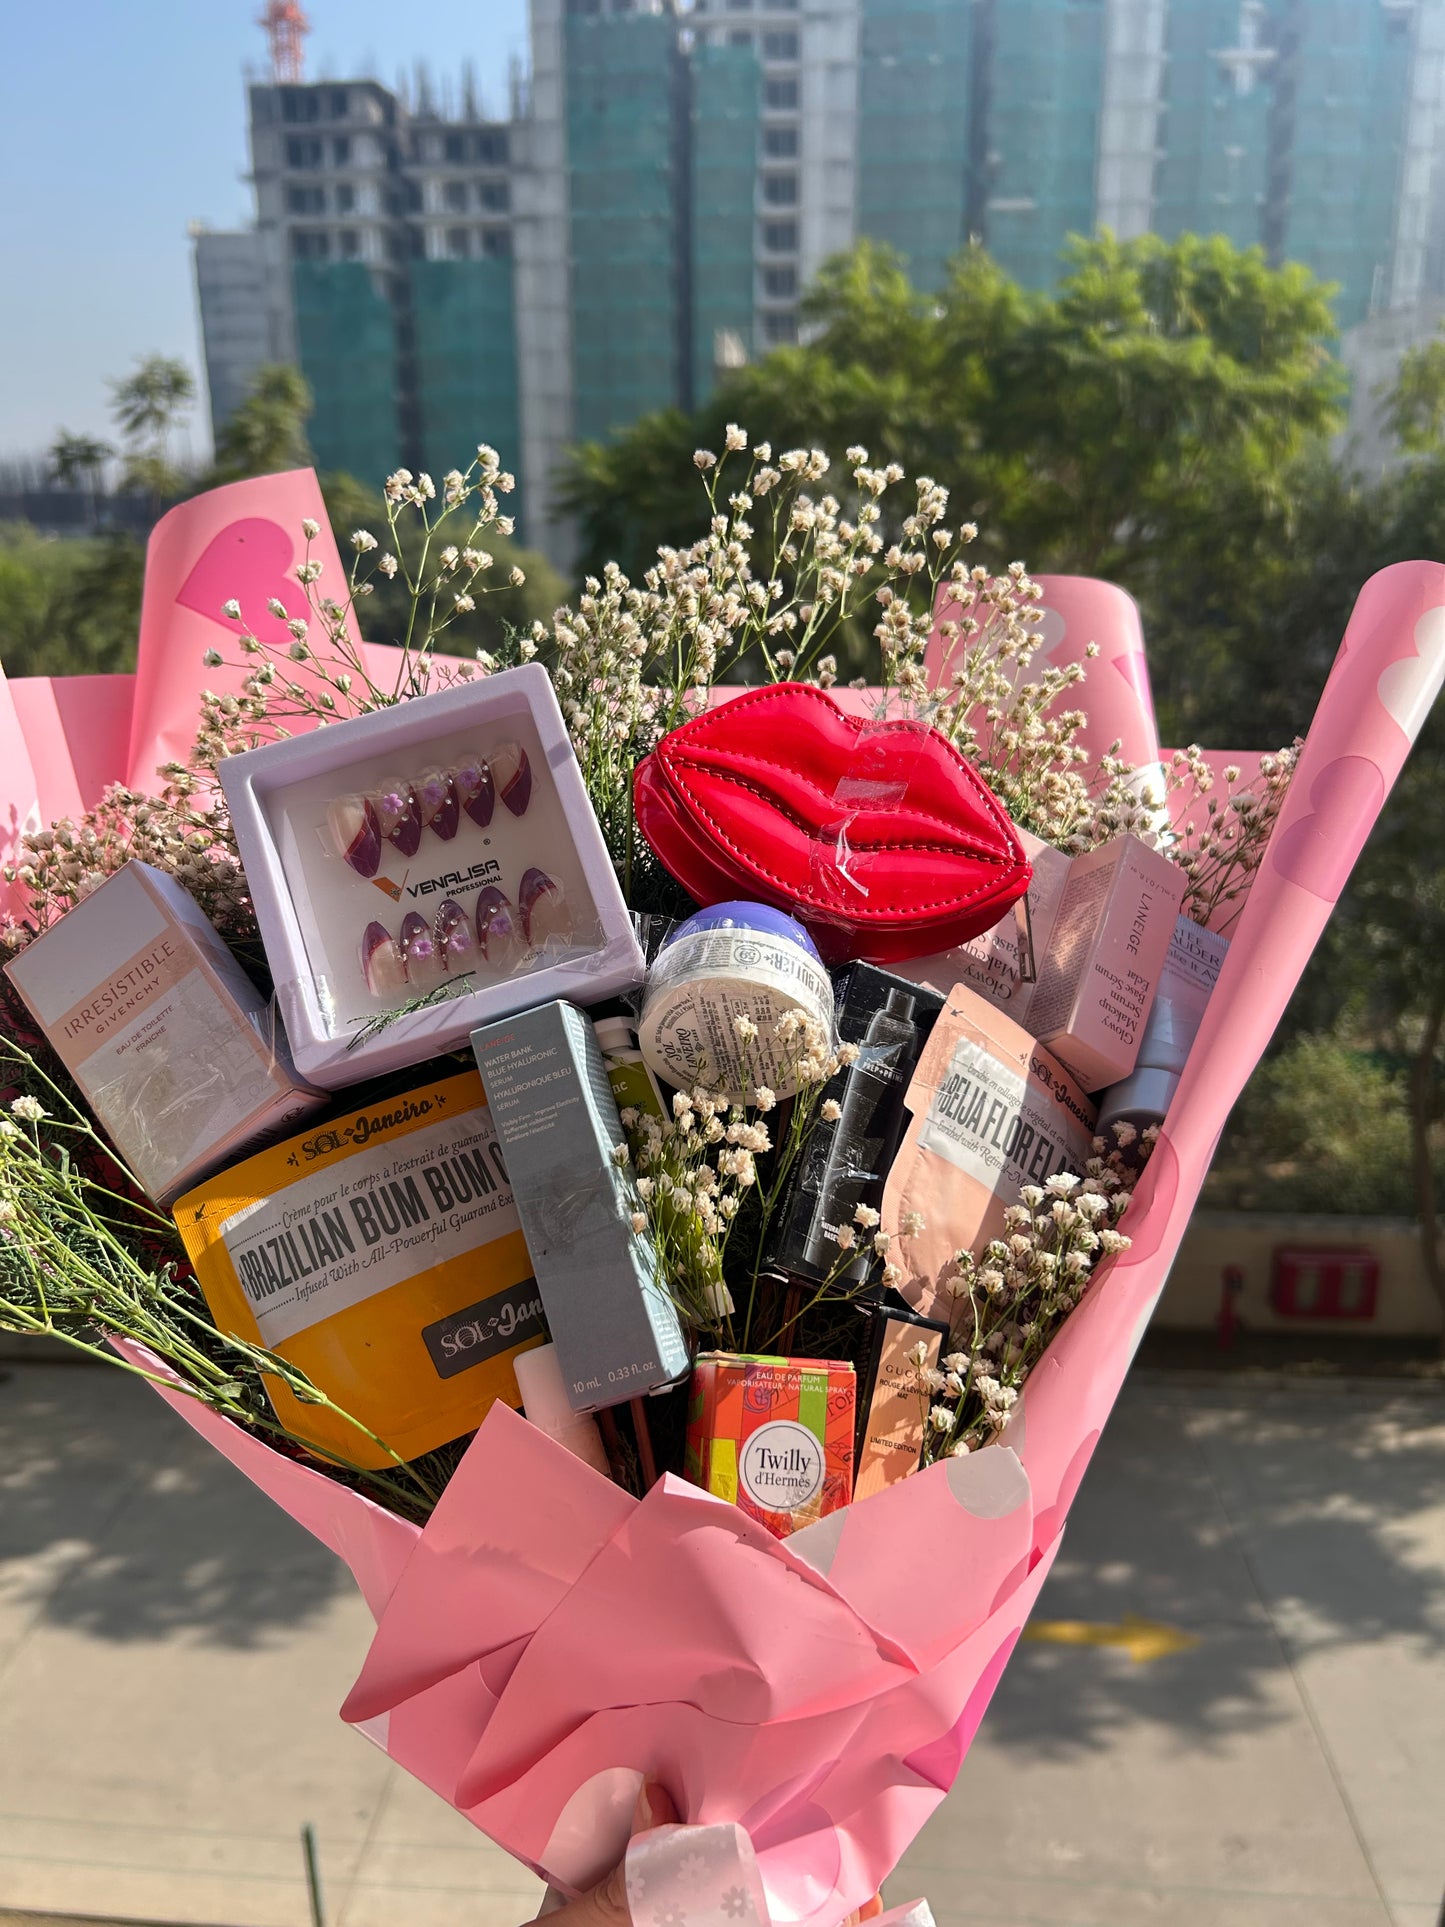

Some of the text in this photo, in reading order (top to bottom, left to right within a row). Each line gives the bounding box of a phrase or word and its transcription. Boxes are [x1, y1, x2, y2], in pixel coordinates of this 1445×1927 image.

[406, 859, 500, 898] VENALISA
[446, 875, 503, 897] PROFESSIONAL
[1126, 892, 1153, 956] LANEIGE
[963, 963, 1012, 1000] Glowy
[1125, 984, 1145, 1005] Base
[96, 976, 160, 1034] GIVENCHY
[1099, 998, 1138, 1033] Makeup
[1110, 990, 1142, 1019] Serum
[116, 1004, 174, 1055] EAU DE TOILETTE
[480, 1033, 515, 1052] LANEIGE
[1101, 1015, 1134, 1045] Glowy
[484, 1044, 533, 1068] WATER BANK
[487, 1047, 558, 1078] BLUE HYALURONIC
[662, 1041, 682, 1062] SOL
[490, 1075, 514, 1089] SERUM
[494, 1067, 572, 1100] HYALURONIQUE BLEU
[1031, 1056, 1054, 1090] SOL
[1055, 1084, 1096, 1132] Janeiro
[302, 1100, 433, 1161] SOL Janeiro
[961, 1135, 980, 1154] with
[980, 1098, 1035, 1170] FLOR
[1049, 1127, 1057, 1138] et
[282, 1128, 490, 1229] Crème pour le corps à l'extrait de guaraná
[239, 1206, 356, 1301] BRAZILIAN
[348, 1175, 430, 1247] BUM
[422, 1148, 498, 1214] BUM
[295, 1277, 328, 1302] Infused
[329, 1259, 360, 1283] With
[449, 1200, 497, 1232] Guaraná
[441, 1320, 493, 1357] SOL
[573, 1361, 657, 1394] 10 mL 0.33 fl. oz.
[726, 1377, 848, 1394] VAPORISATEUR NATURAL SPRAY
[756, 1371, 821, 1384] EAU DE PARFUM
[880, 1378, 901, 1390] ROUGE
[897, 1392, 909, 1400] MAT
[870, 1436, 917, 1454] LIMITED EDITION
[755, 1447, 811, 1475] Twilly
[755, 1471, 811, 1488] d'Hermès
